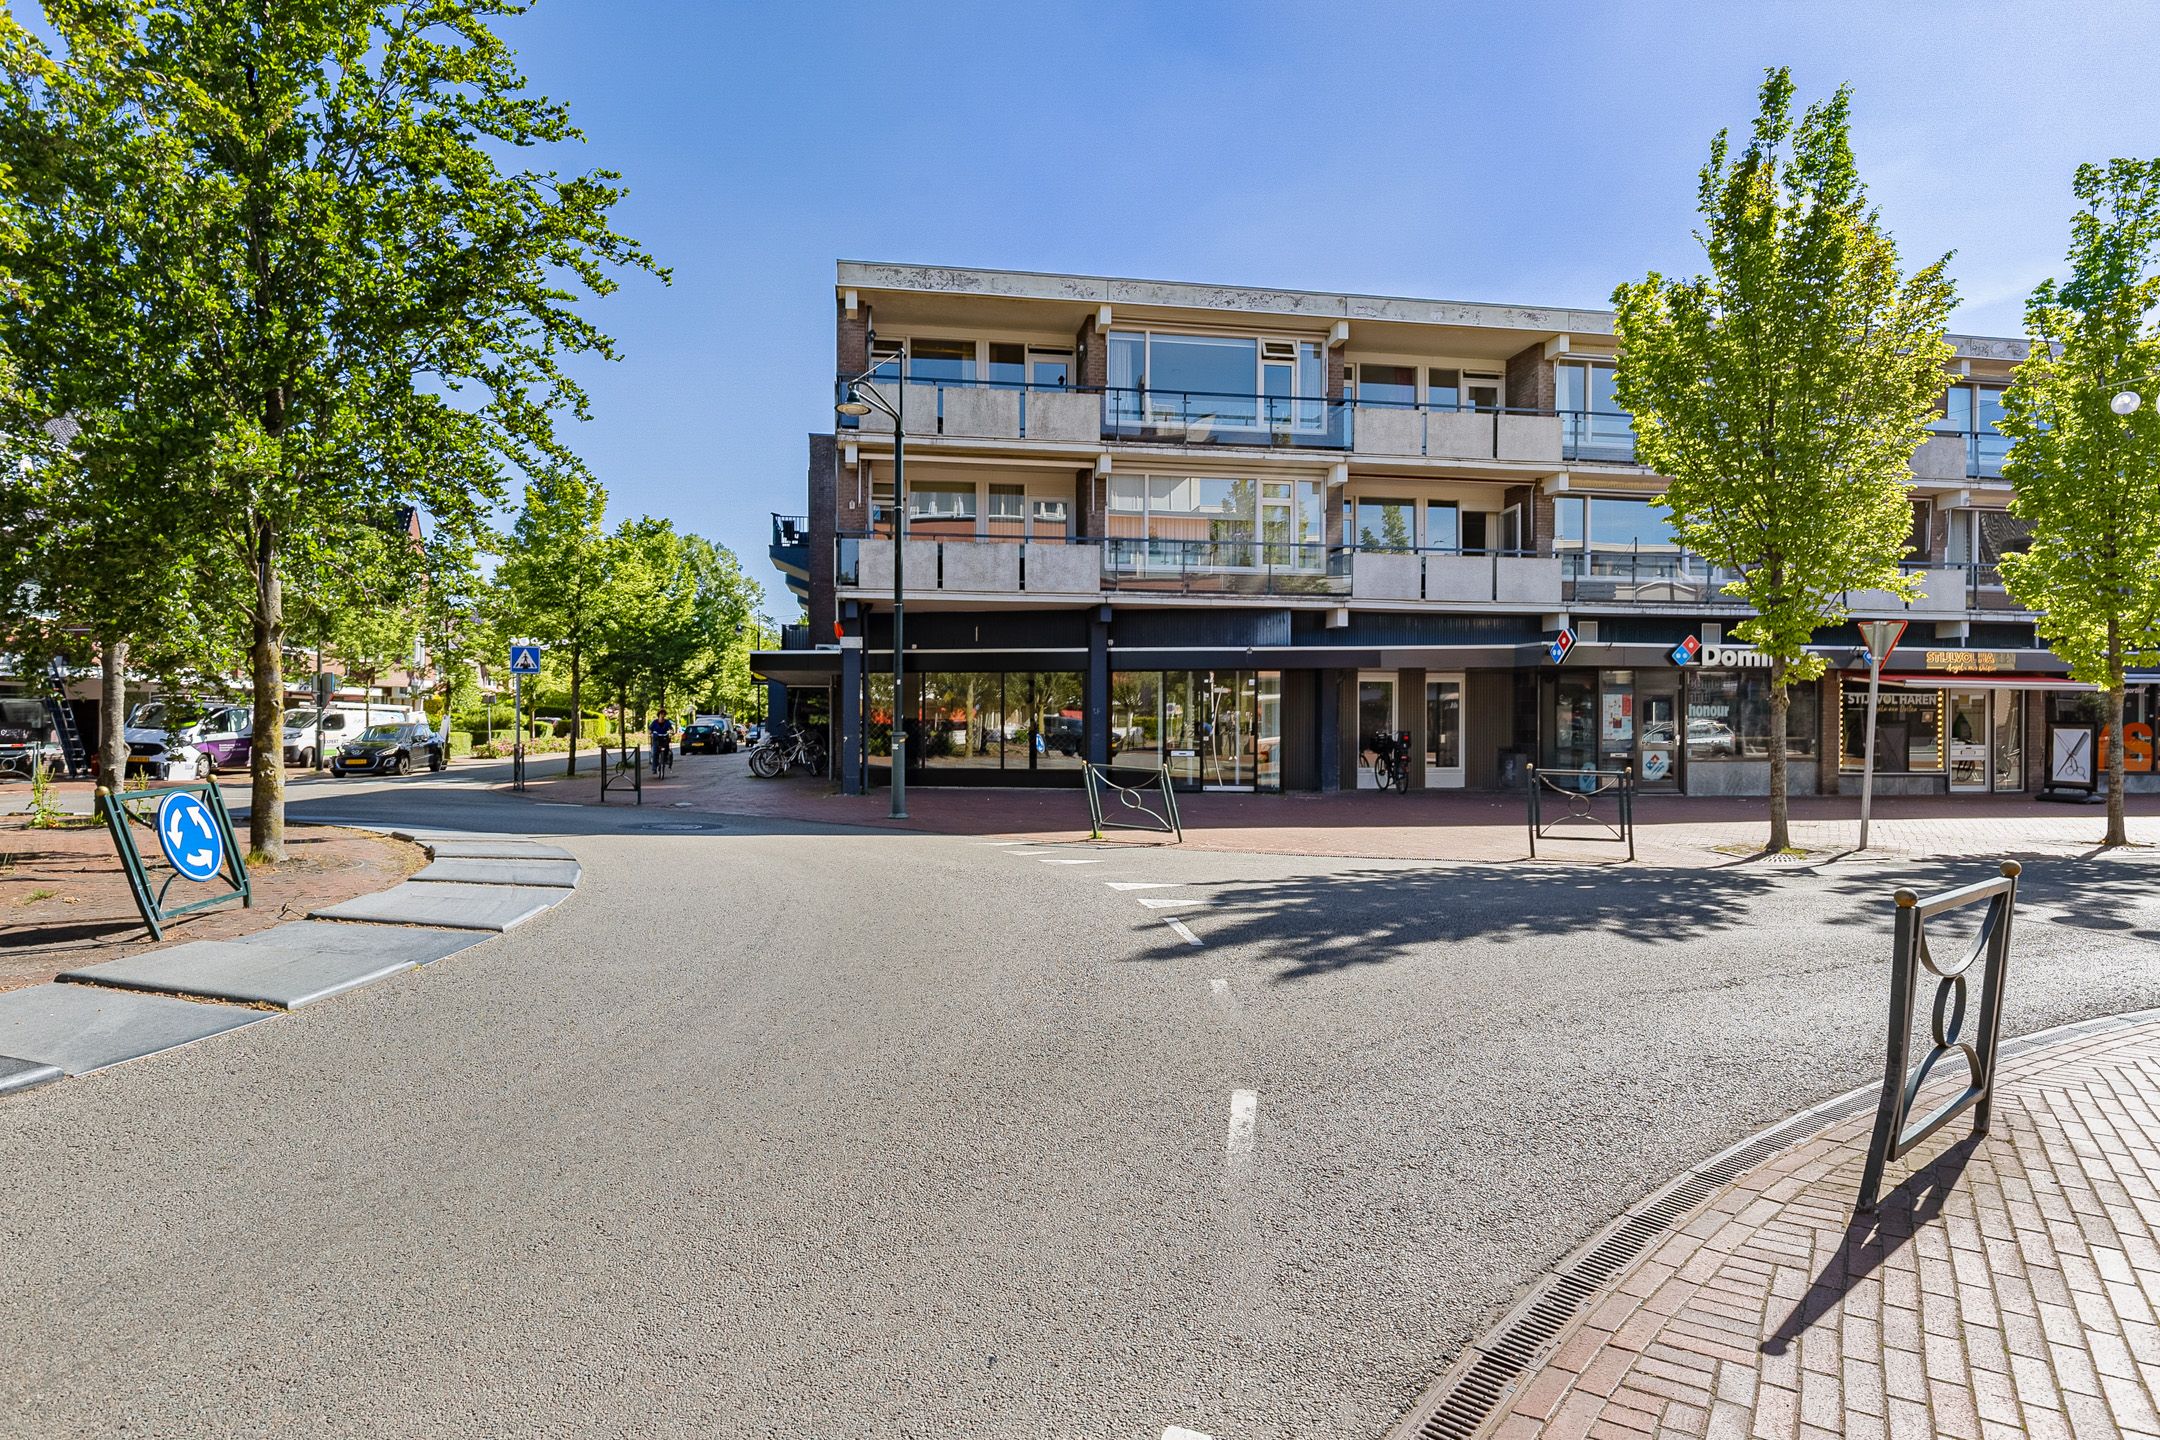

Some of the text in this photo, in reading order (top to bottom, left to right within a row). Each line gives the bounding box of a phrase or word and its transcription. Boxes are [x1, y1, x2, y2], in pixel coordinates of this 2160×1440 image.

[1926, 651, 1975, 664] STIJLVOL
[1847, 693, 1937, 705] STIJVOL HAREN
[1688, 703, 1730, 717] honour
